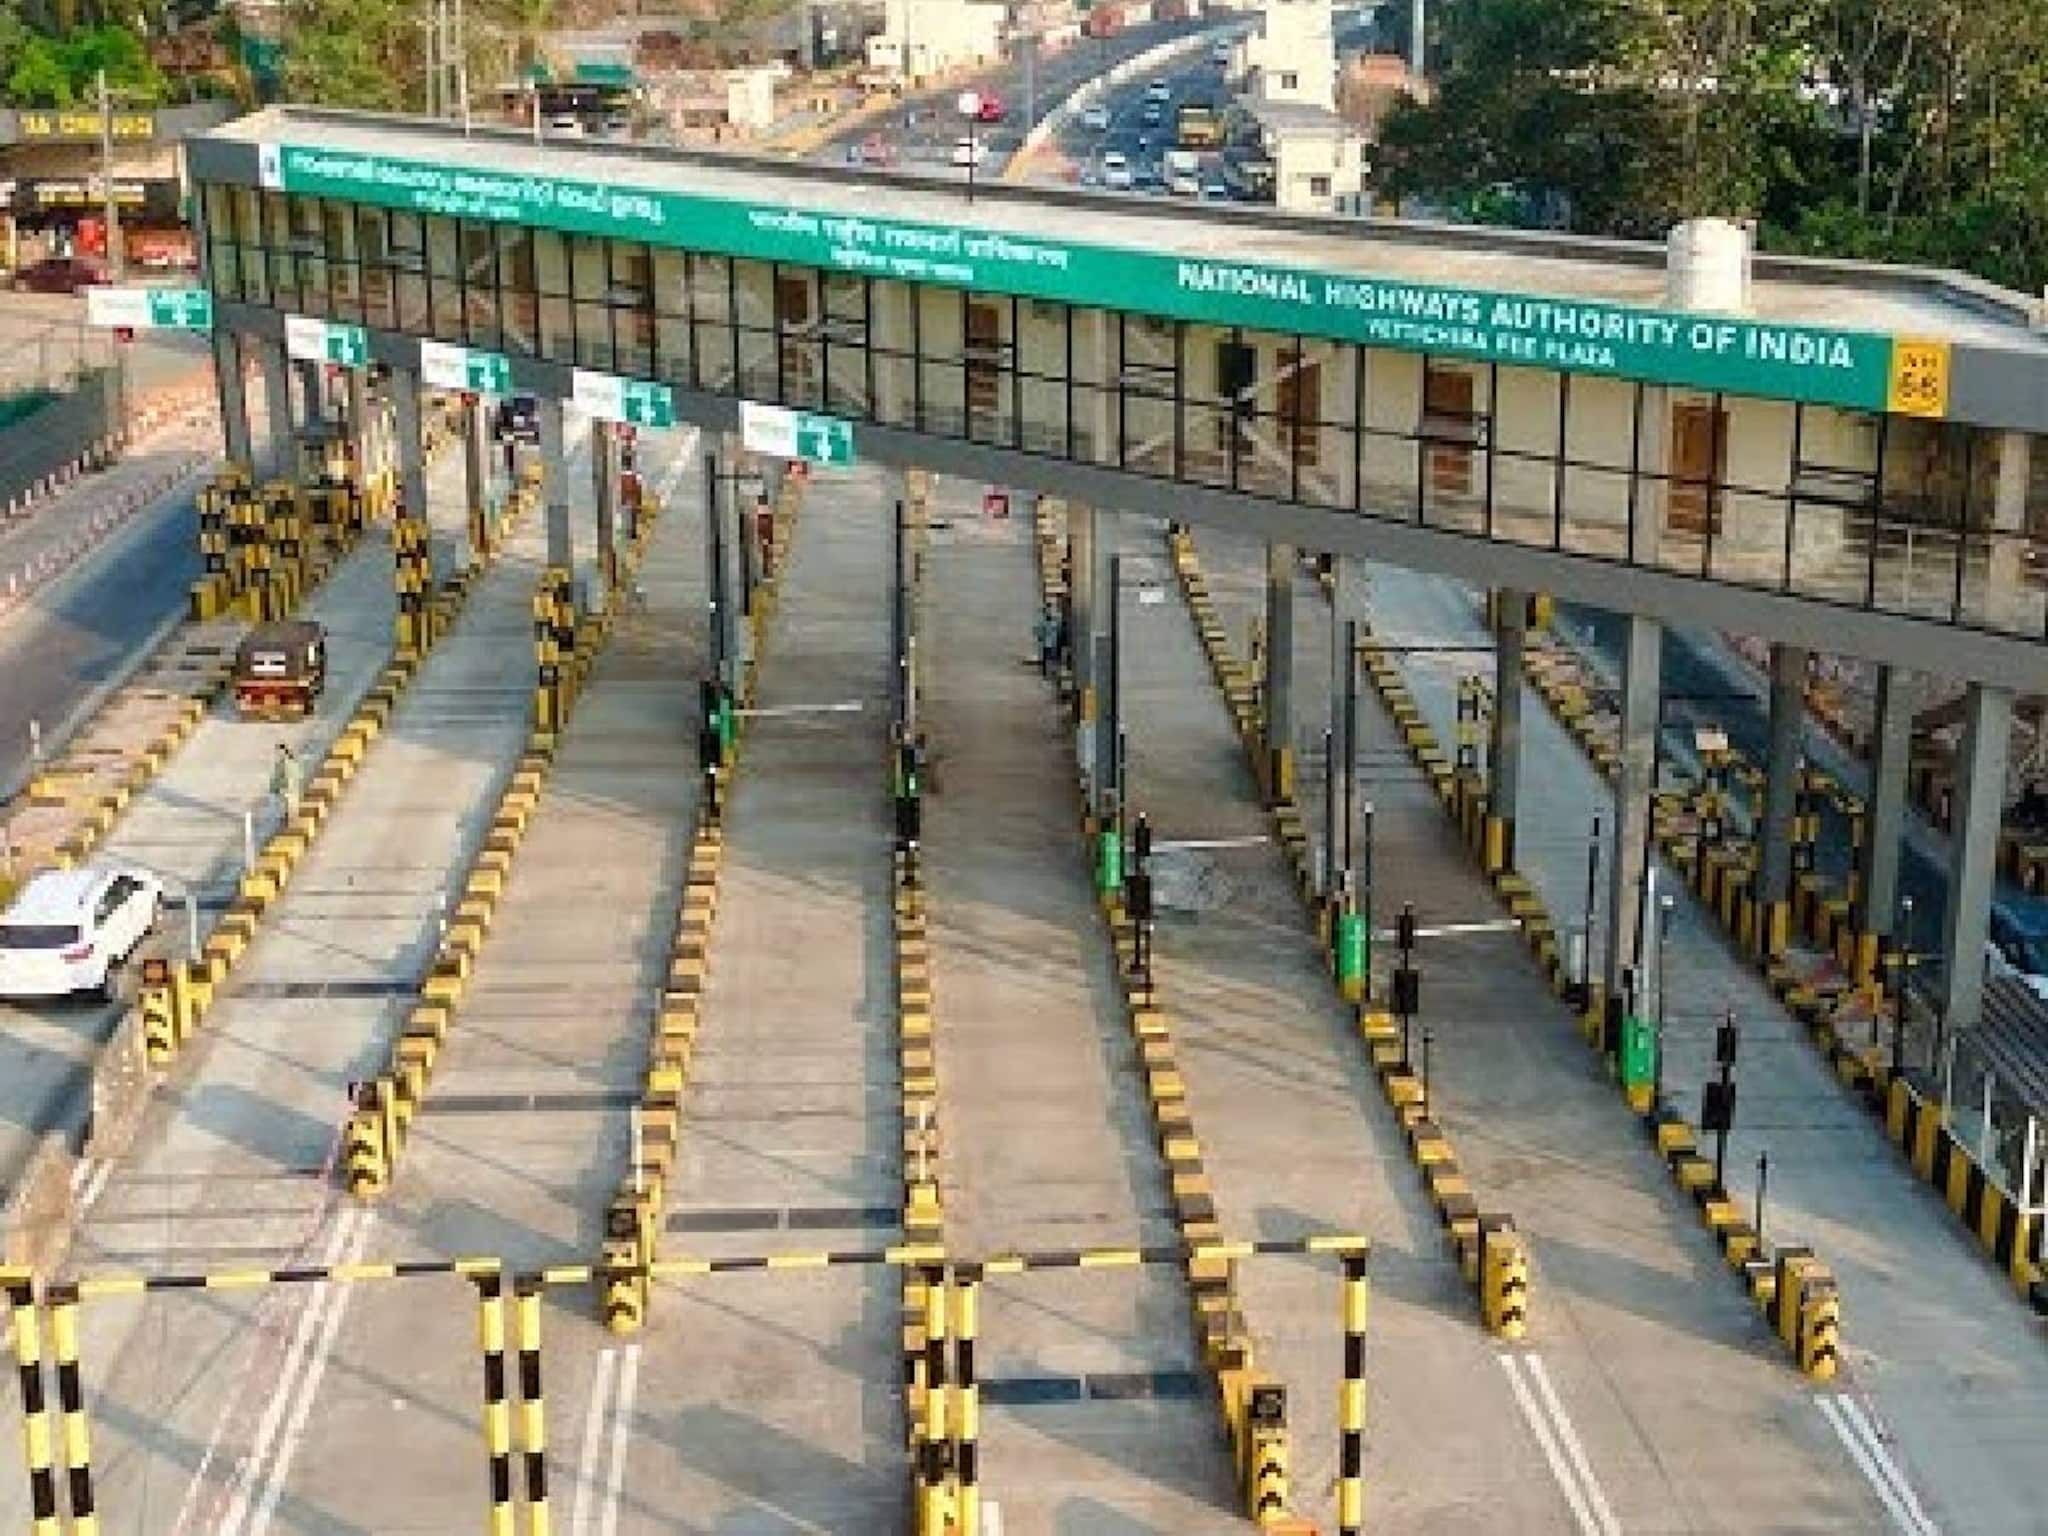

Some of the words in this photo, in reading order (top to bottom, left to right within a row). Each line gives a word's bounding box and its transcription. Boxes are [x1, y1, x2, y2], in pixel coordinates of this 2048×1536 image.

[1178, 263, 1312, 304] NATIONAL
[1325, 281, 1480, 323] HIGHWAYS
[1491, 302, 1679, 345] AUTHORITY
[1689, 323, 1737, 352] OF
[1746, 333, 1854, 368] INDIA
[1545, 342, 1616, 368] PLAZA
